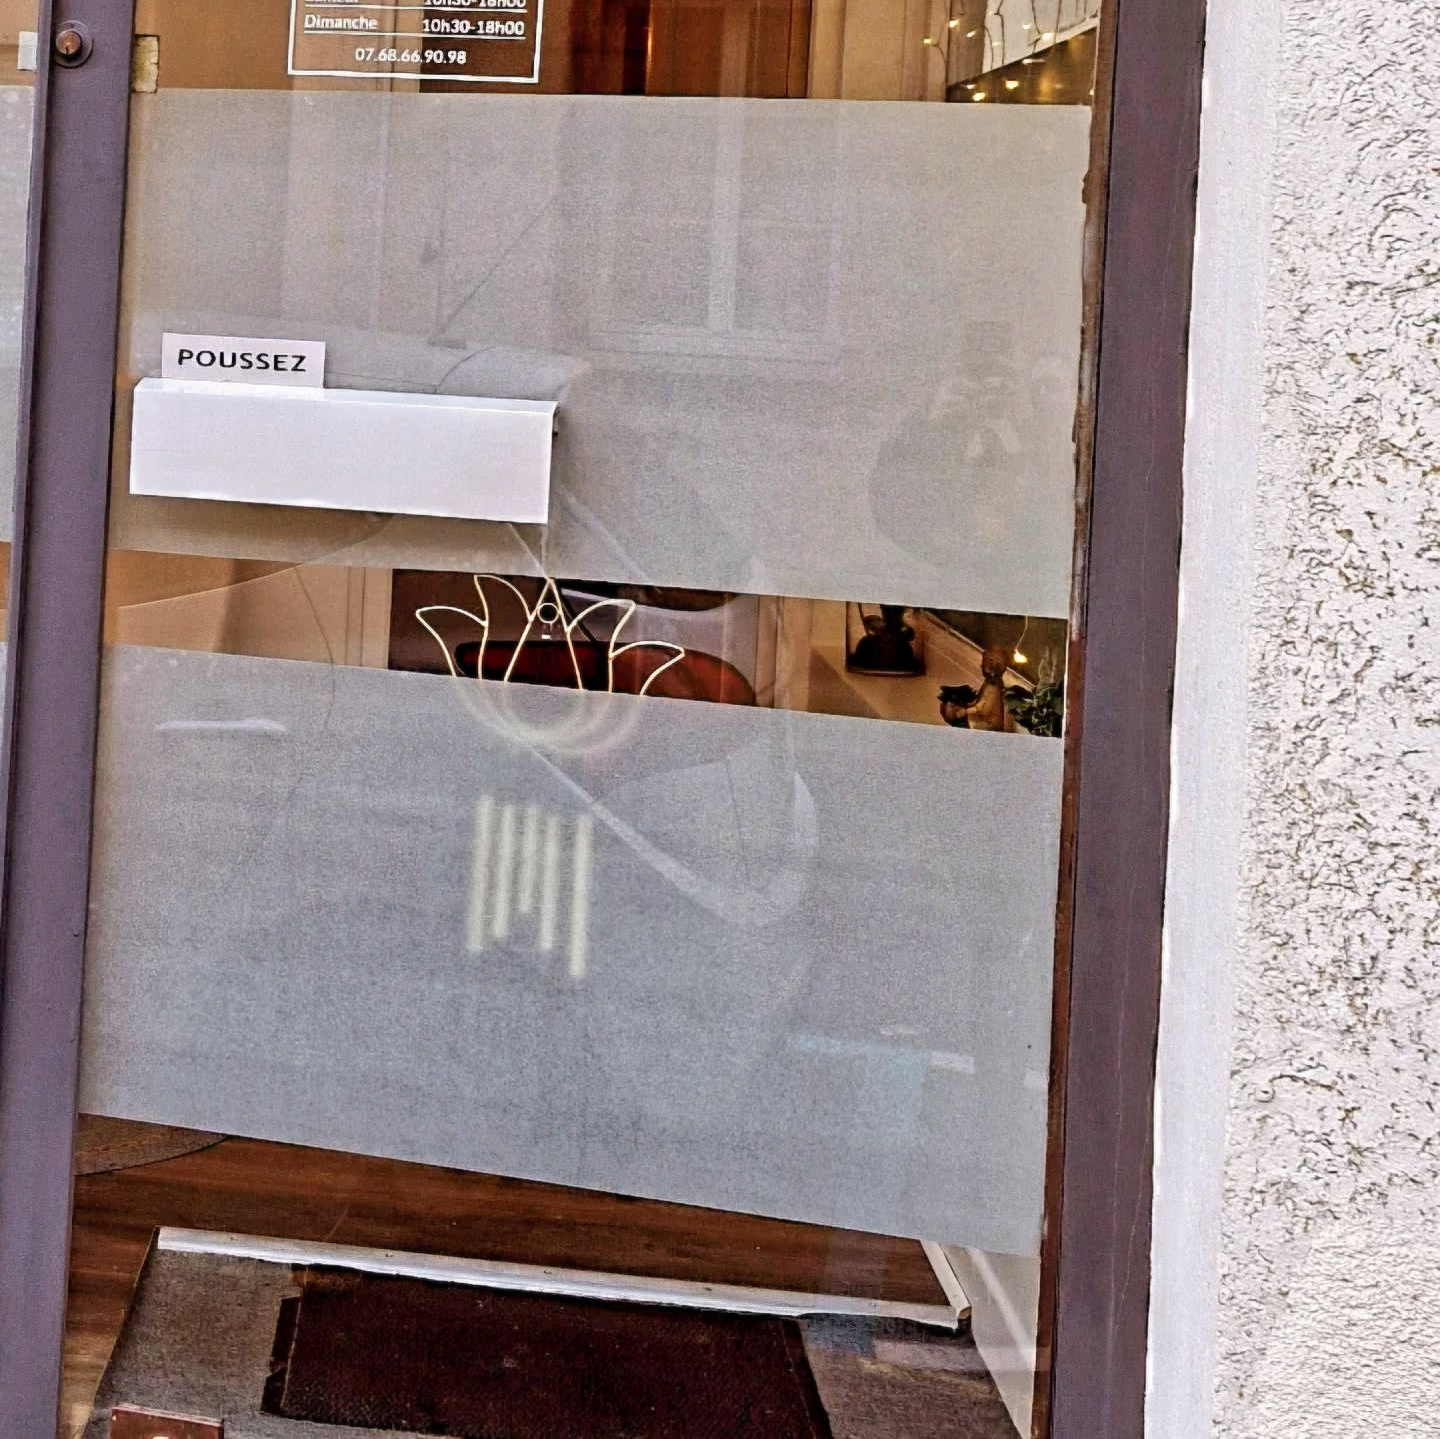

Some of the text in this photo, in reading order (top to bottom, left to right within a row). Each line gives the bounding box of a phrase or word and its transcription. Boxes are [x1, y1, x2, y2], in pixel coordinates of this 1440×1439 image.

[304, 14, 525, 35] Dimanche 10h30-18h00
[355, 48, 467, 65] 07.68.66.90.98
[177, 348, 307, 373] POUSSEZ
